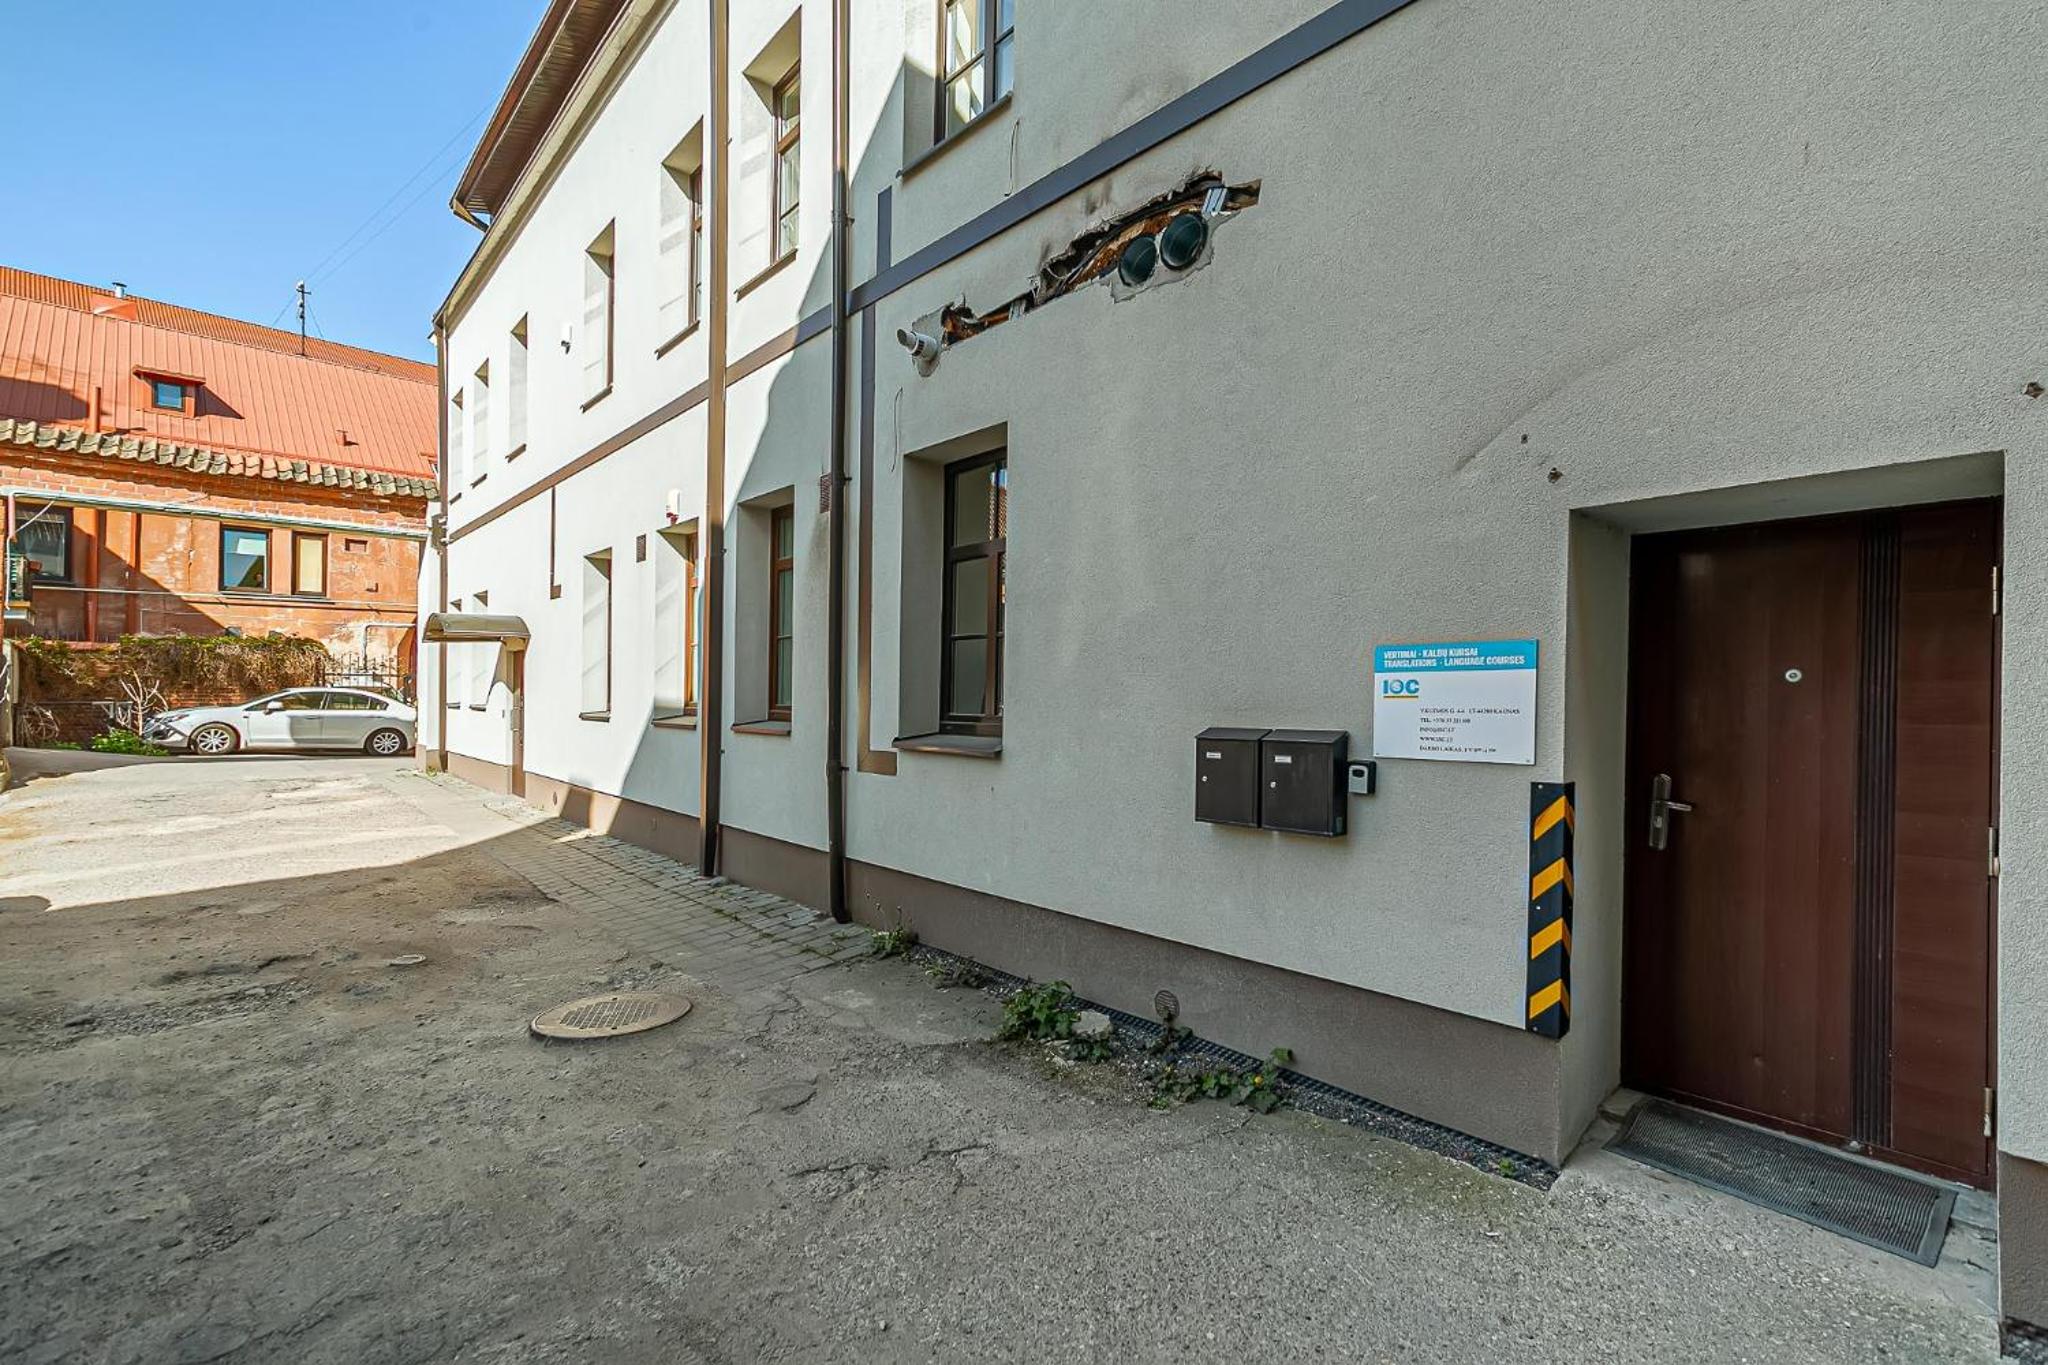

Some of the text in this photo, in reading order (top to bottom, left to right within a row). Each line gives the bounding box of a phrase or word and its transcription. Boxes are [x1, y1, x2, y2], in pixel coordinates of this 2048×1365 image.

[1448, 647, 1478, 657] KURSAI
[1384, 655, 1525, 668] TRANSLATIONS LANGUAGE COURSES
